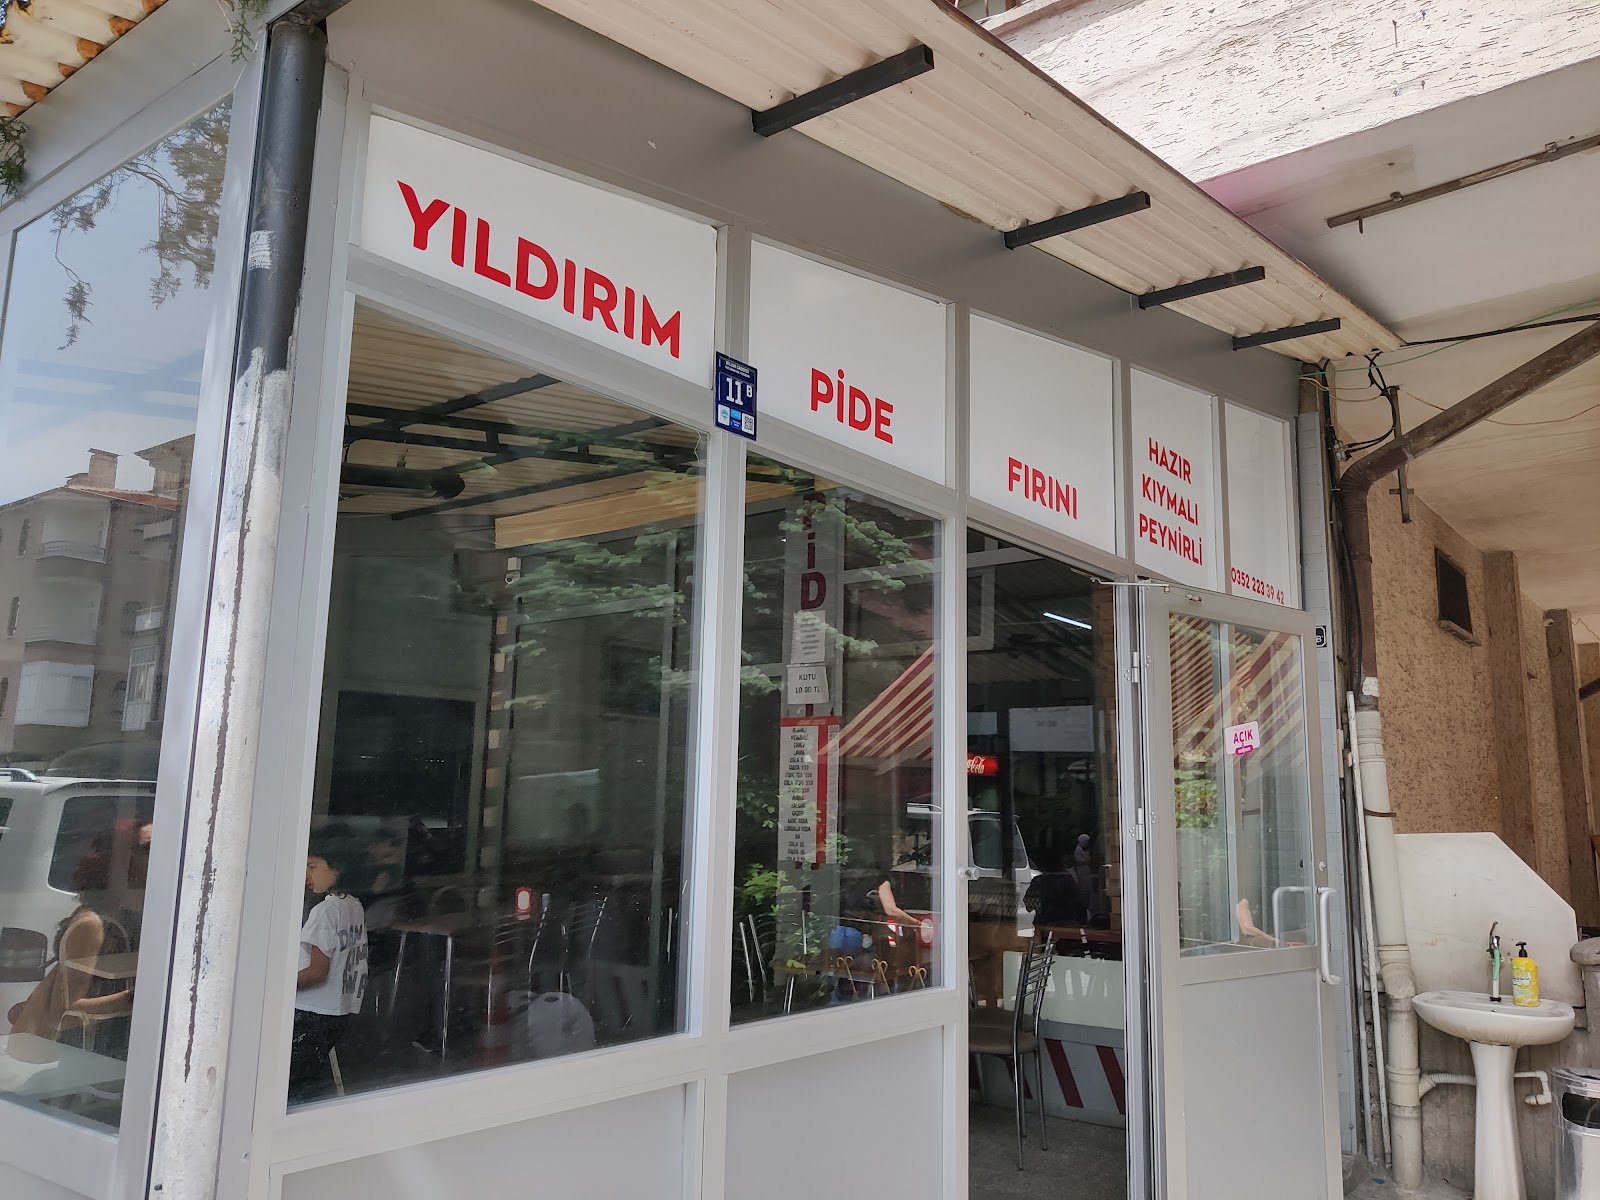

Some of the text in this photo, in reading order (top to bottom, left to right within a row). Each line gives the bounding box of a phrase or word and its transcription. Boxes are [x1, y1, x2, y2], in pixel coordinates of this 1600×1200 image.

[397, 180, 681, 359] YILDIRIM
[726, 377, 753, 406] 11 B
[810, 367, 894, 445] PİDE
[1148, 436, 1192, 485] HAZIR
[1007, 456, 1078, 520] FIRINI
[1142, 473, 1199, 527] KIYMALI
[1139, 513, 1203, 566] PEYNİRLİ
[1231, 567, 1285, 605] 0352 223 39 42
[799, 673, 817, 681] KUTU
[1233, 729, 1254, 747] AÇIK
